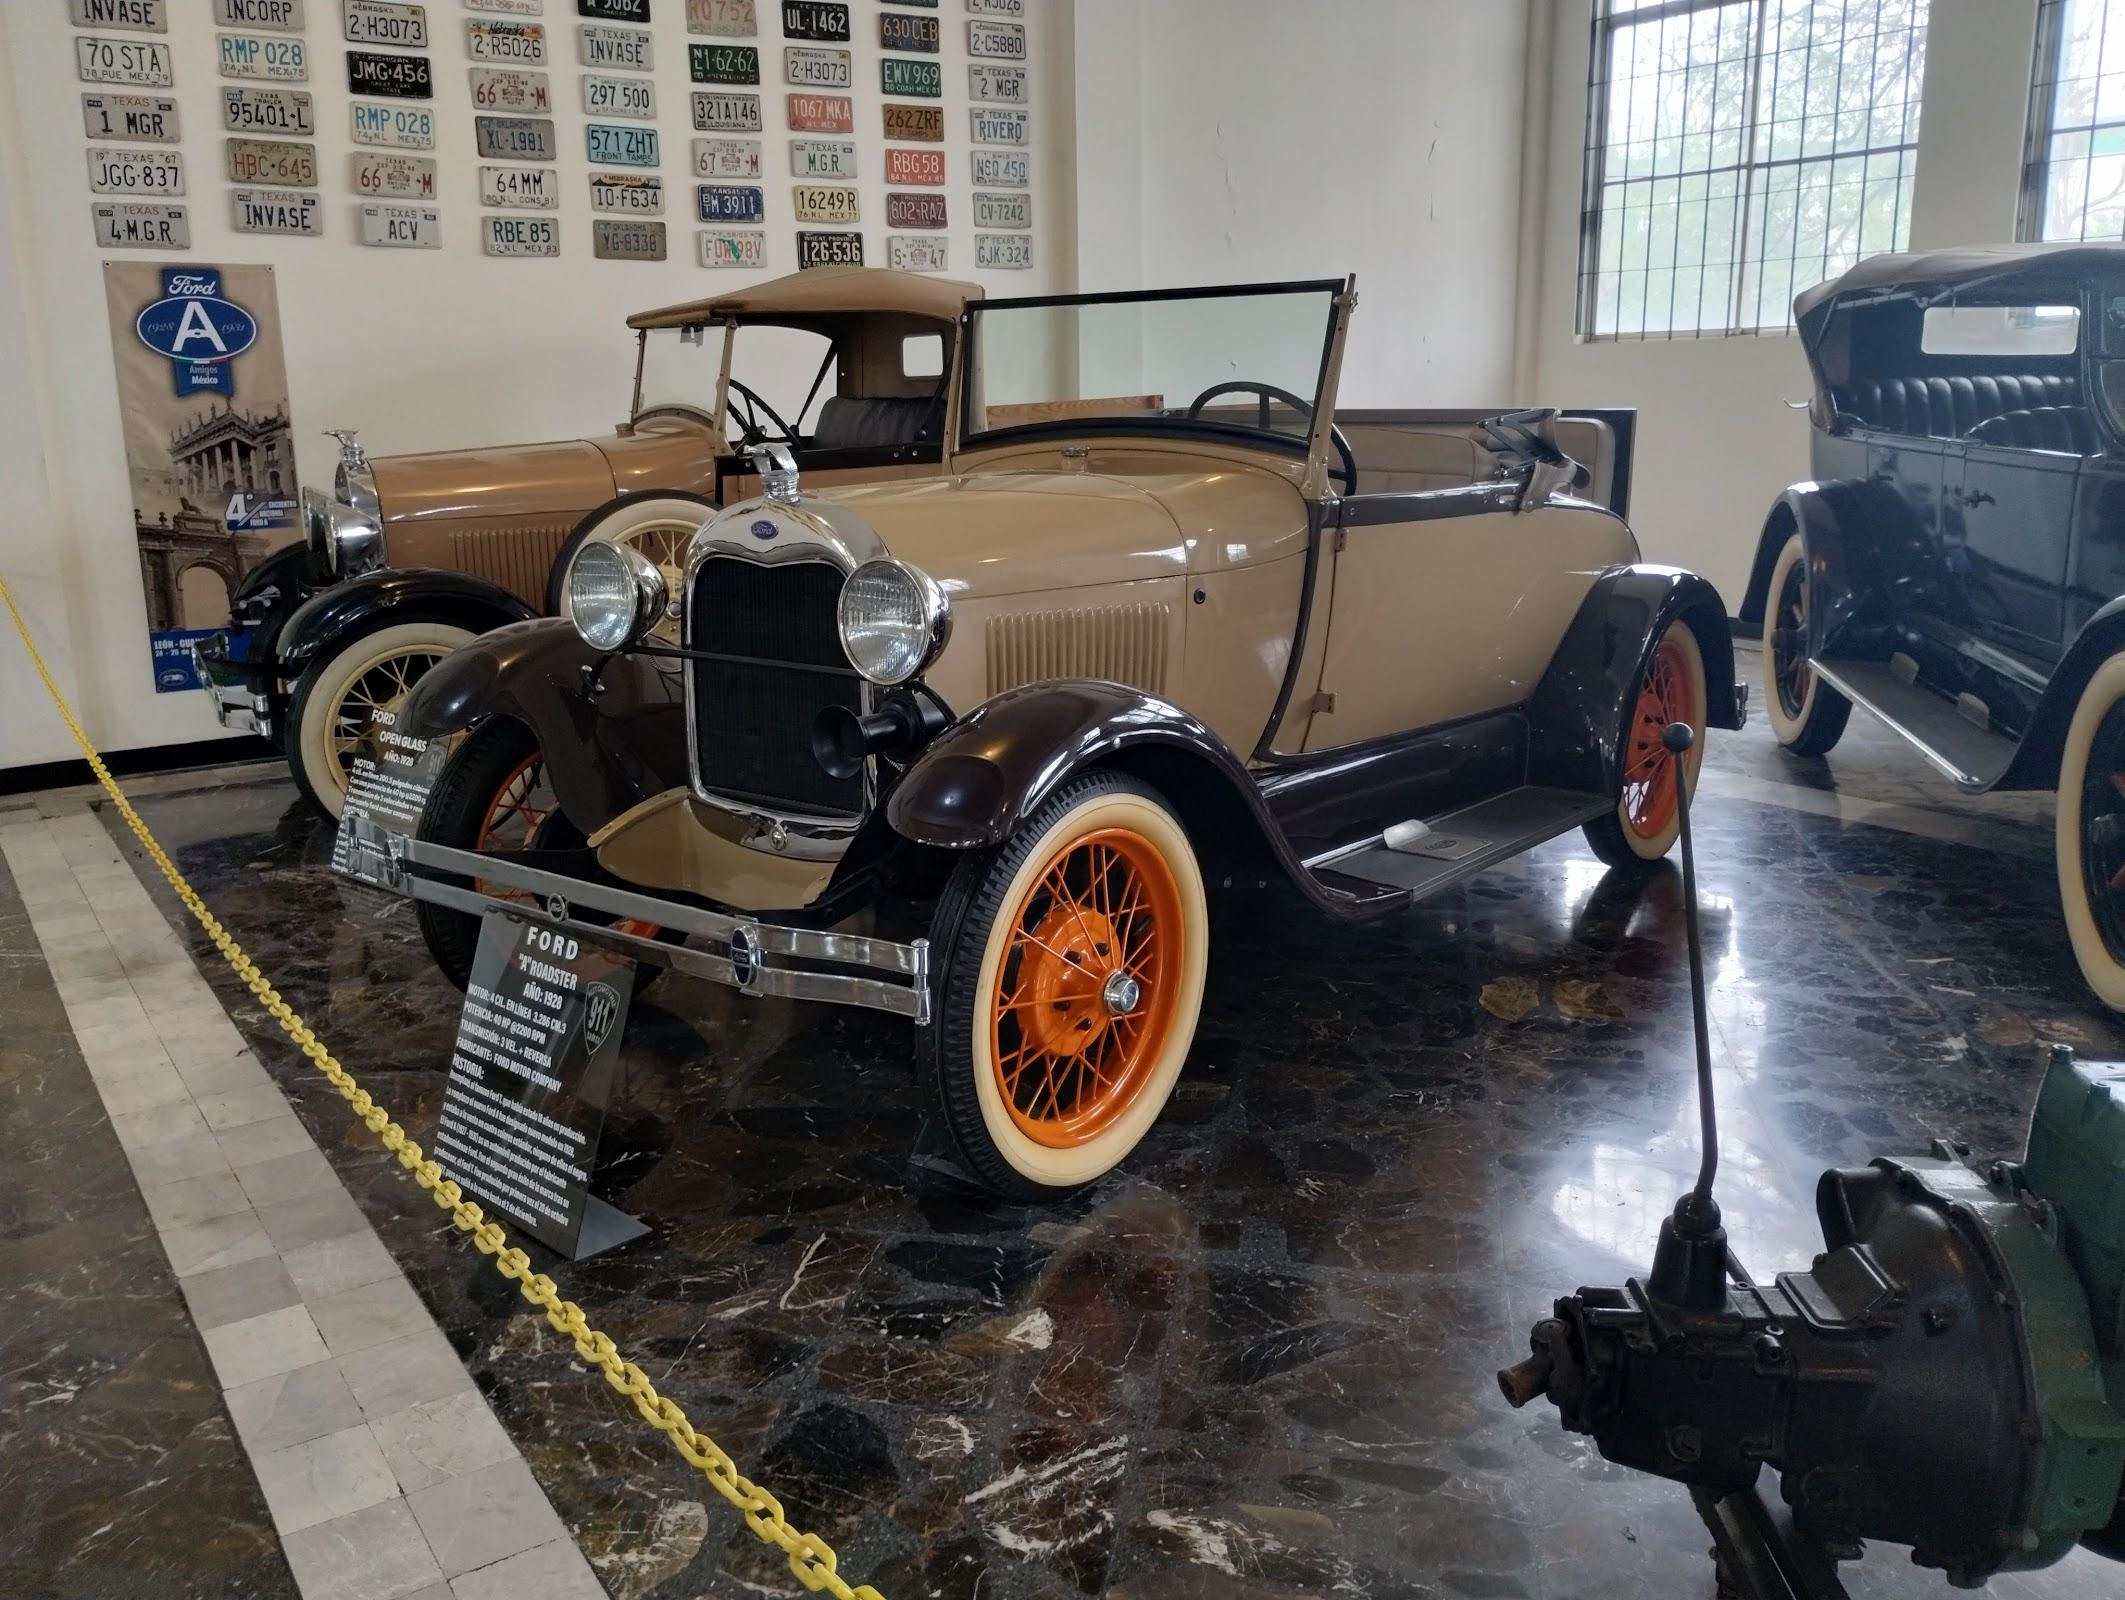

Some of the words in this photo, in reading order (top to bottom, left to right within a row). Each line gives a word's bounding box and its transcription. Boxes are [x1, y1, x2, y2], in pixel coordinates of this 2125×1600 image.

[84, 0, 155, 25] INVASE
[227, 0, 292, 22] INCORP
[602, 30, 632, 41] TEXAS
[883, 18, 910, 38] 630
[87, 43, 114, 68] 70
[121, 45, 162, 72] STA
[221, 38, 260, 63] RMP
[265, 42, 303, 67] 028
[590, 39, 644, 64] INVASE
[102, 70, 122, 80] PUE
[129, 72, 151, 81] MEX
[884, 63, 911, 84] EWV
[913, 65, 939, 86] 969
[477, 83, 496, 104] 66
[590, 84, 616, 107] 297
[623, 87, 650, 109] 500
[996, 79, 1019, 97] MGR
[112, 96, 151, 107] TEXAS
[101, 110, 113, 133] 1
[126, 112, 163, 137] MGR
[355, 106, 390, 131] RMP
[395, 111, 430, 135] 028
[887, 109, 914, 128] 262
[590, 130, 621, 152] 571
[625, 131, 655, 155] ZHT
[812, 143, 838, 152] TEXAS
[116, 152, 155, 164] TEXAS
[596, 151, 622, 161] FRONT
[893, 152, 920, 173] RBG
[922, 154, 939, 174] 58
[360, 167, 381, 189] 66
[497, 173, 517, 193] 64
[521, 173, 543, 195] MM
[261, 192, 296, 203] TEXAS
[724, 195, 755, 215] 3911
[799, 191, 844, 210] 16249
[123, 205, 160, 215] TEXAS
[245, 203, 312, 229] INVASE
[385, 207, 417, 219] TEXAS
[388, 219, 418, 241] ACV
[493, 221, 527, 244] RBE
[530, 223, 551, 243] 85
[168, 275, 217, 296] Ford
[171, 301, 228, 352] A
[189, 364, 218, 375] Amigos
[371, 709, 396, 726] FORD
[379, 730, 402, 748] OPEN
[401, 736, 427, 753] GLASS
[353, 757, 376, 771] MOTOR:
[527, 926, 578, 959] FORD
[468, 983, 489, 1001] MOTOR:
[522, 981, 543, 1002] AÑO:
[543, 990, 562, 1009] 1928
[463, 1000, 493, 1021] POTENCIA:
[501, 1016, 511, 1028] HP
[531, 1029, 546, 1044] RPM
[588, 996, 610, 1034] 911
[460, 1018, 500, 1044] TRANSMISIÓN:
[523, 1046, 551, 1067] REVERSA
[452, 1053, 484, 1079] HISTORIA:
[456, 1036, 492, 1060] FABRICANTE:
[493, 1053, 510, 1069] FORD
[509, 1060, 531, 1078] MOTOR
[530, 1070, 561, 1092] COMPANY
